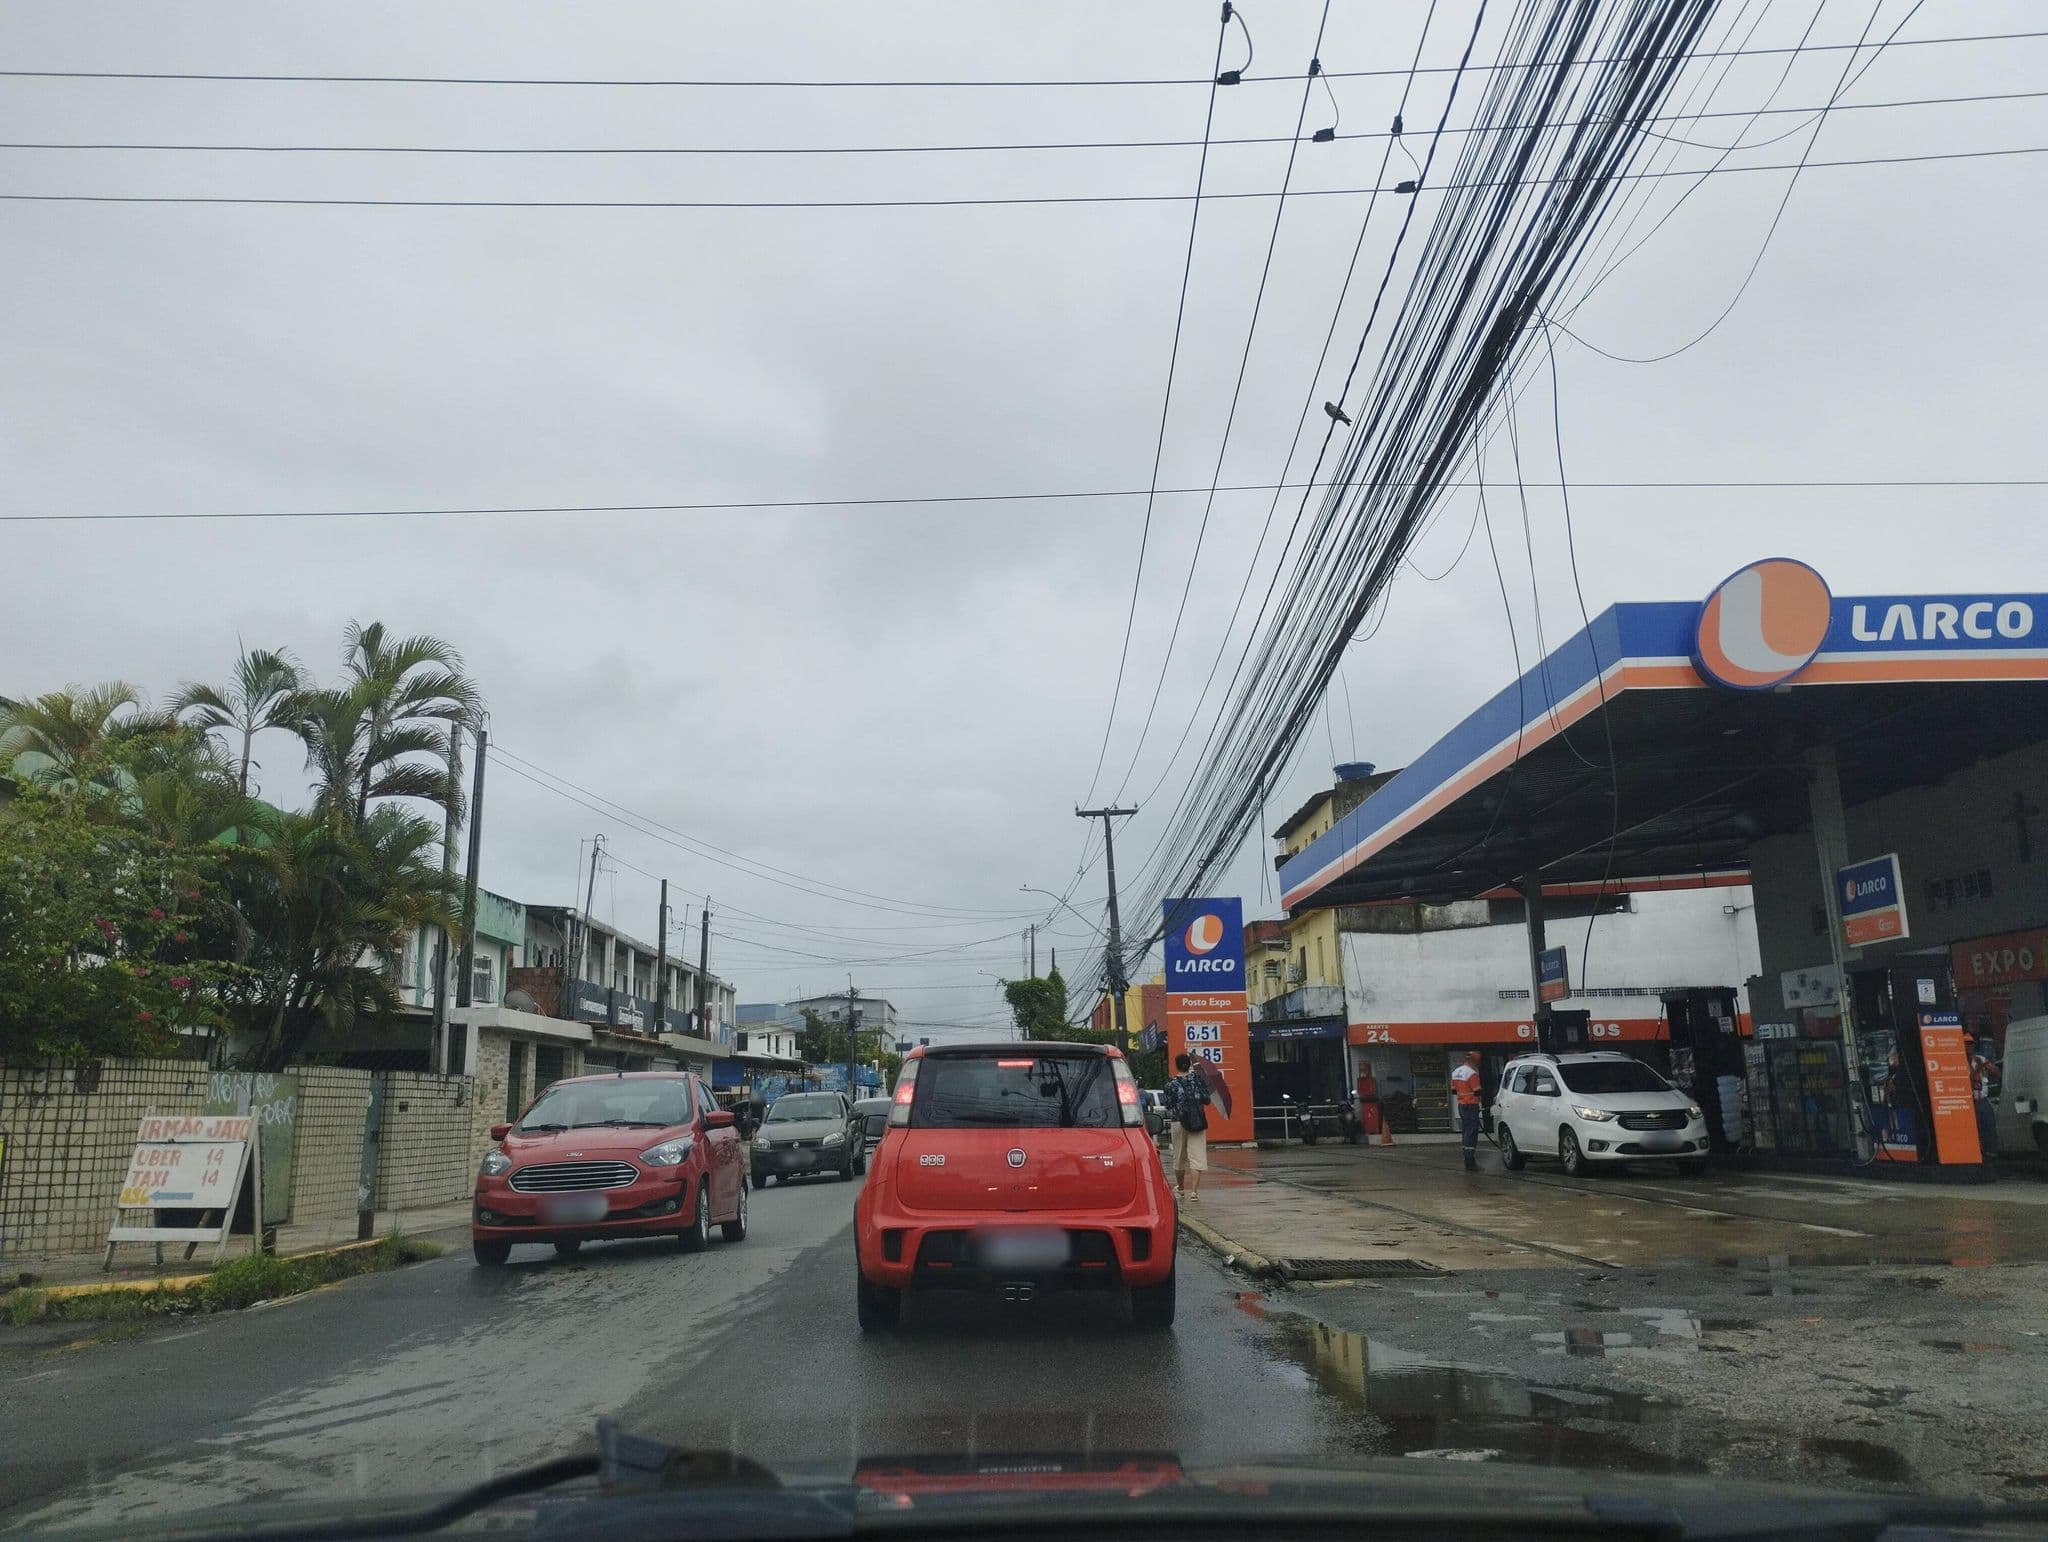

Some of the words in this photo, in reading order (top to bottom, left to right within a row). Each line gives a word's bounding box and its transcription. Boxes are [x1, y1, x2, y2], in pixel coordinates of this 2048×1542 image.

[1852, 601, 2033, 642] LARCO
[1857, 877, 1886, 896] LARCO
[1175, 958, 1235, 973] LARCO
[1972, 948, 2033, 976] EXPO
[1182, 997, 1207, 1007] Posto
[1208, 997, 1232, 1009] Expo
[1187, 1025, 1218, 1041] 6,51
[137, 1150, 182, 1166] UBER
[207, 1149, 225, 1165] 14
[132, 1170, 170, 1187] TAXI
[202, 1169, 219, 1186] 14
